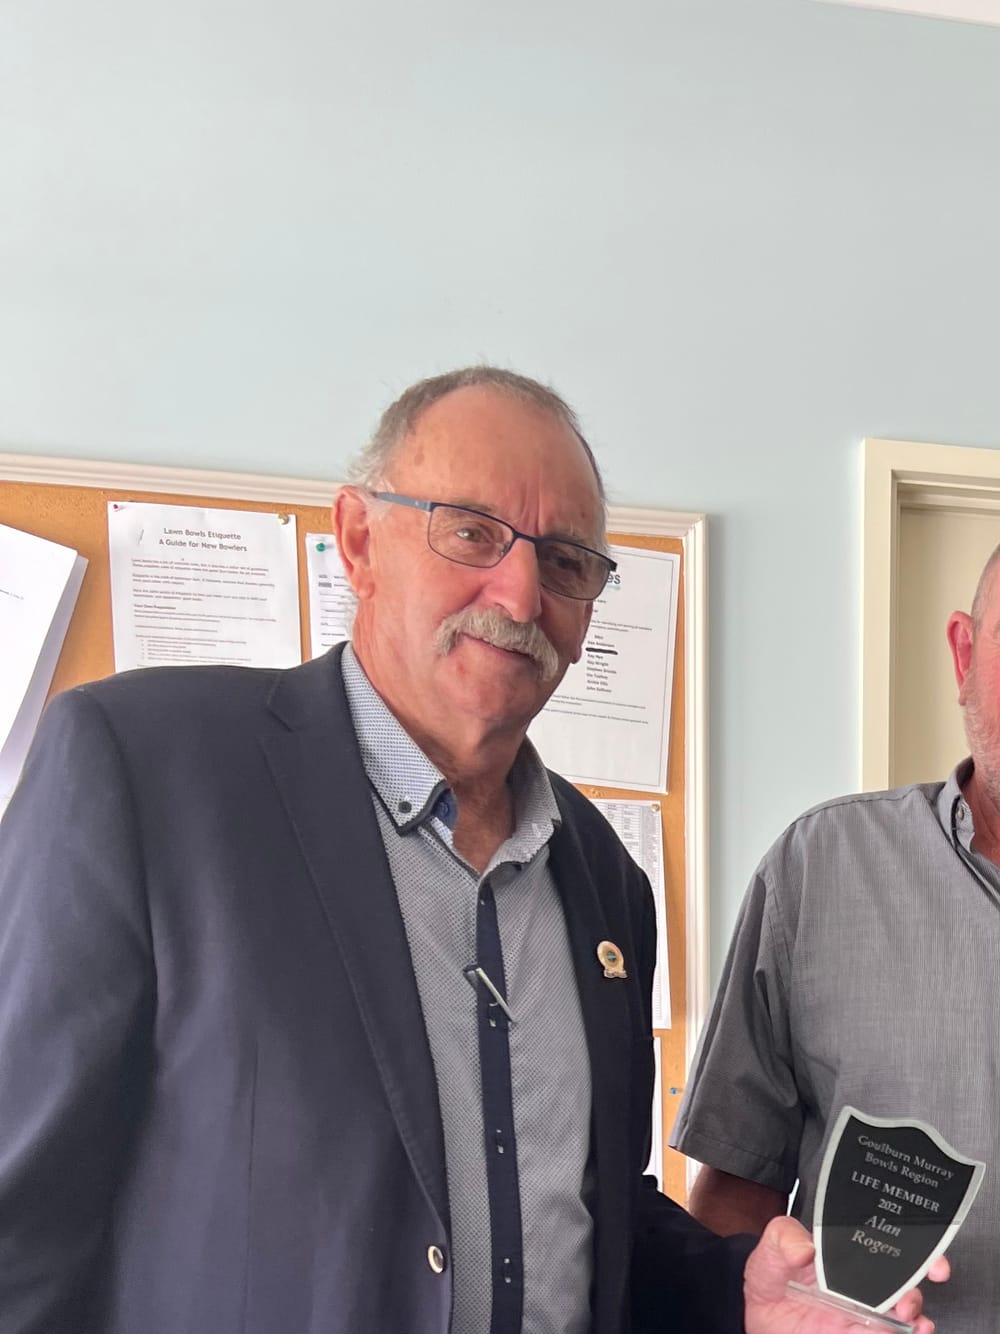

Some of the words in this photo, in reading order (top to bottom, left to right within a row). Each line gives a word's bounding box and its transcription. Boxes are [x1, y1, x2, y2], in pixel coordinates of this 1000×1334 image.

[163, 527, 184, 536] Lawn
[185, 529, 206, 538] Bowls
[208, 530, 242, 541] Etiquette
[165, 538, 187, 548] Guide
[188, 540, 199, 549] for
[201, 542, 217, 550] New
[219, 543, 247, 552] Bowlers
[858, 1134, 912, 1163] Goulburn
[913, 1155, 955, 1180] Murray
[864, 1151, 899, 1174] Bowls
[900, 1165, 940, 1189] Region
[851, 1170, 881, 1190] LIFE
[881, 1182, 941, 1213] MEMBER
[878, 1198, 903, 1216] 2021
[864, 1215, 902, 1237] Alan
[851, 1229, 902, 1258] Rogers
